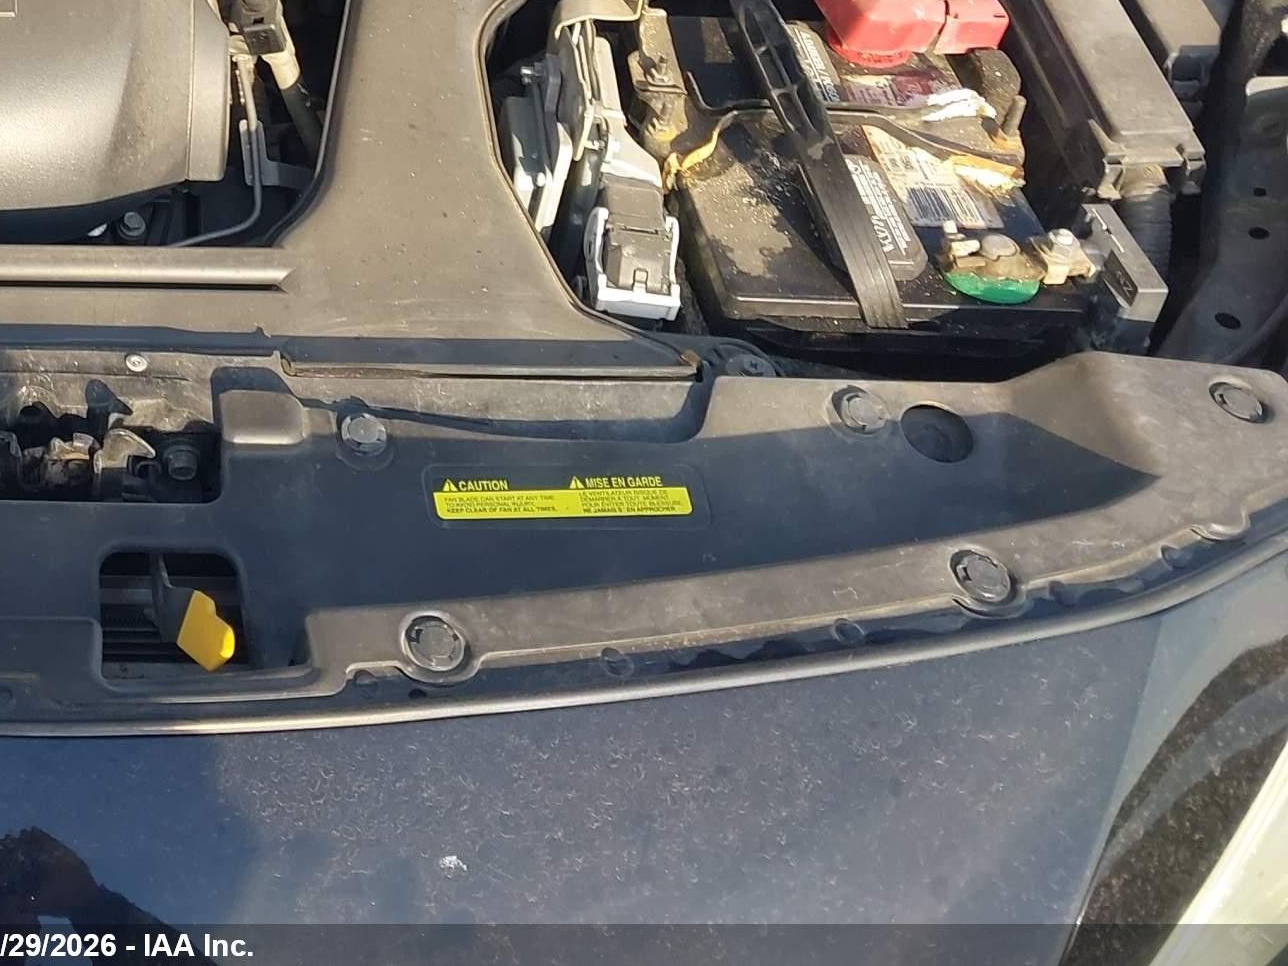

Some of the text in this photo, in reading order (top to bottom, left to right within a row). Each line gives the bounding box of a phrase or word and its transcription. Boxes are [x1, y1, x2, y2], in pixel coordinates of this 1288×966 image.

[458, 479, 509, 491] CAUTION
[584, 476, 664, 489] MISE EN GARDE
